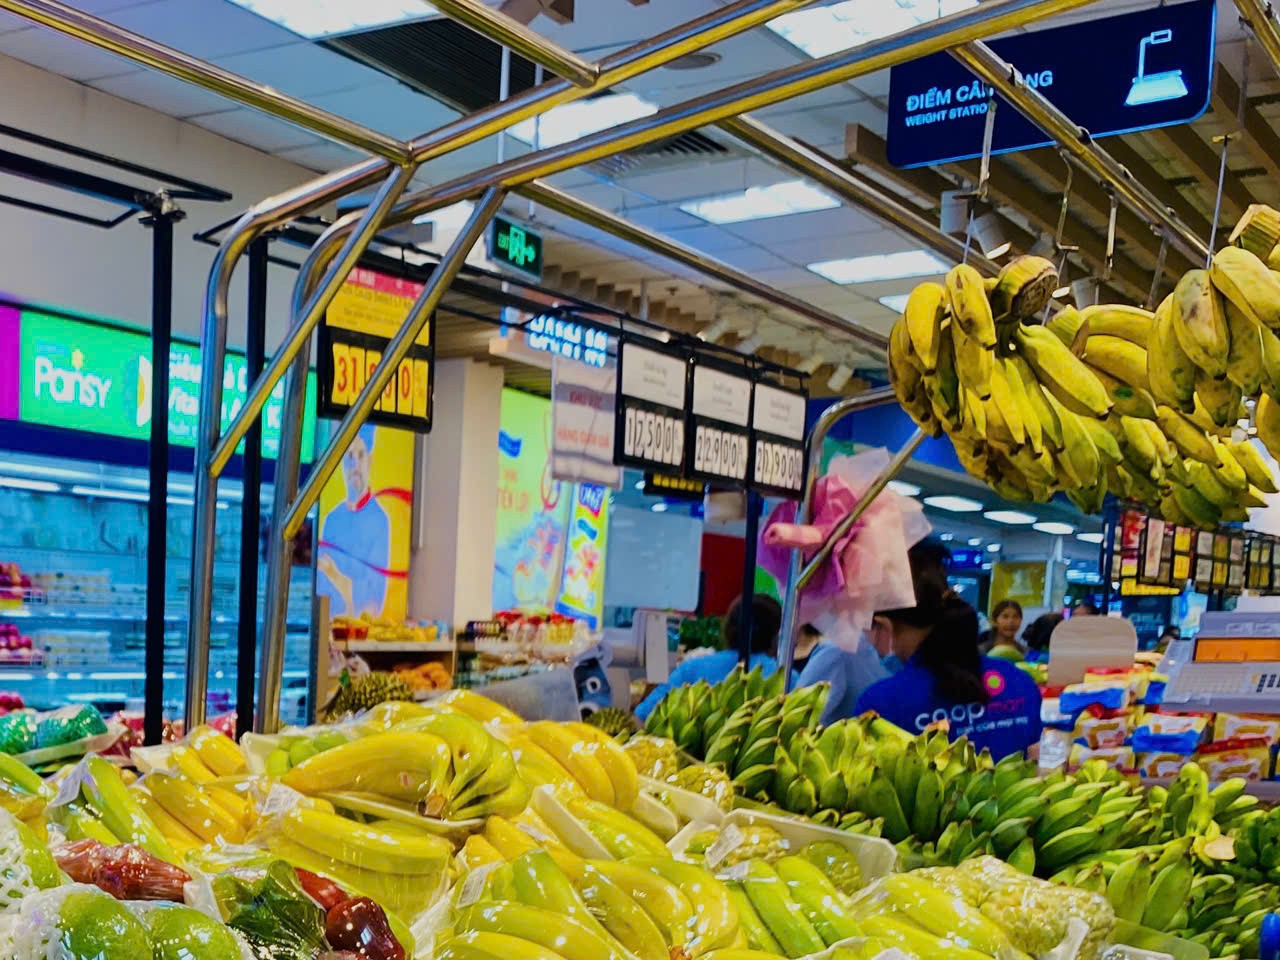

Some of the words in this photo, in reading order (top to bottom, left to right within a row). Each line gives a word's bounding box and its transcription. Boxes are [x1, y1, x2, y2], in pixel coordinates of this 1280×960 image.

[906, 86, 951, 112] ĐIỂM
[905, 110, 947, 127] WEIGHT
[949, 103, 989, 120] STATIO
